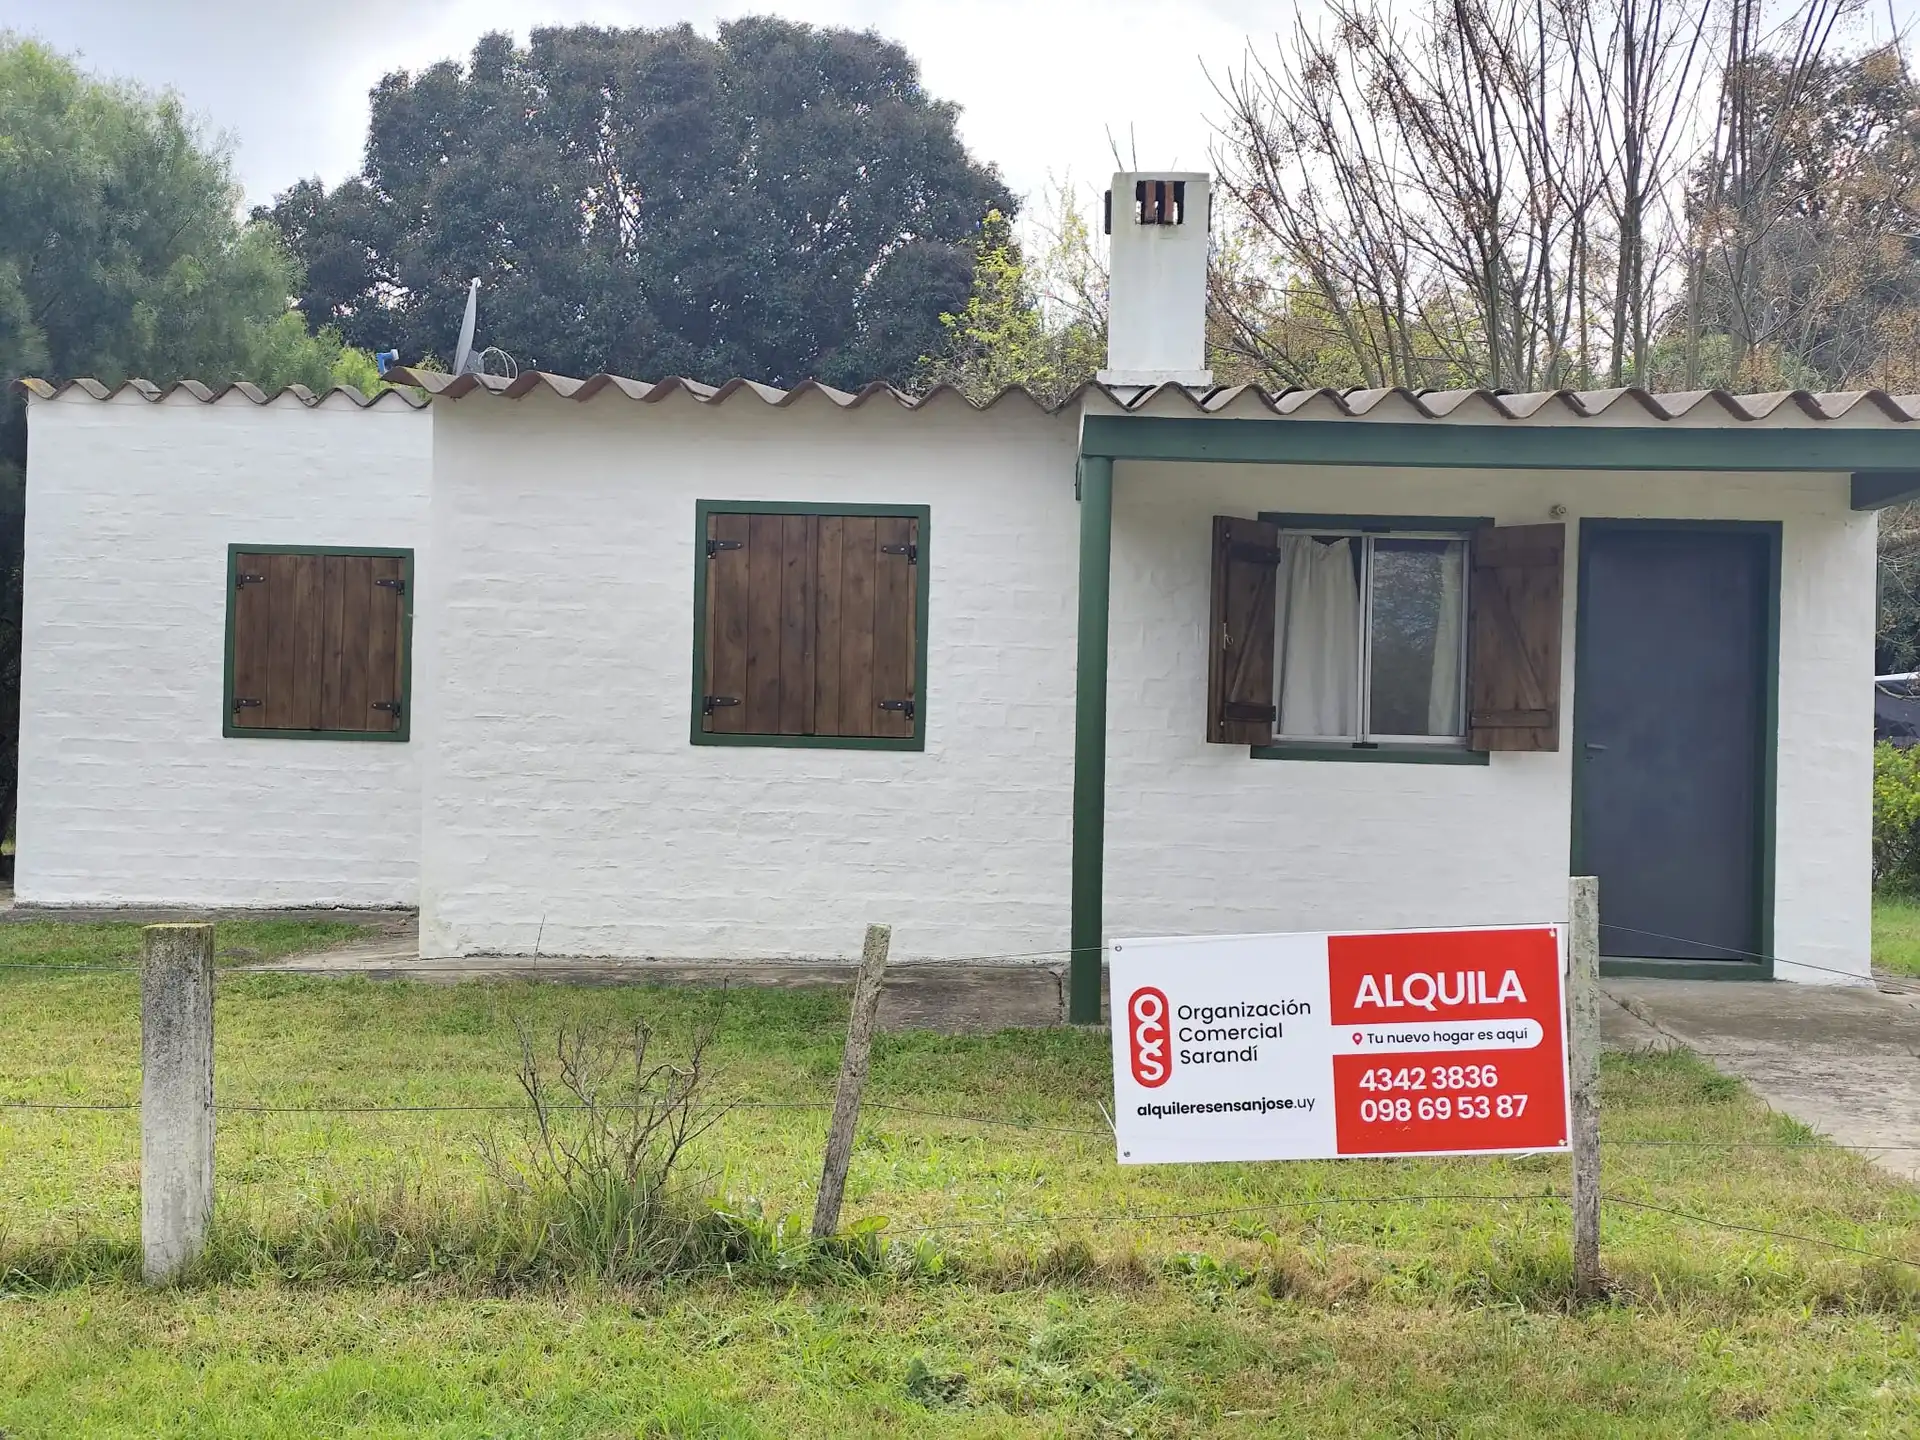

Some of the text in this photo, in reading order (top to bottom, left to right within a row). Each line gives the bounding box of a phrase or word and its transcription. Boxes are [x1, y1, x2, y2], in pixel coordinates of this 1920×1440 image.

[1353, 969, 1527, 1012] ALQUILA
[1177, 999, 1311, 1024] Organización
[1178, 1023, 1283, 1042] Comercial
[1367, 1027, 1528, 1045] Tu nuevo hogar es aquí
[1180, 1045, 1258, 1064] Sarandí
[1359, 1064, 1498, 1092] 4342 3836
[1137, 1097, 1316, 1119] alquileresensanjose.uy
[1360, 1094, 1528, 1122] 098 69 53 87
